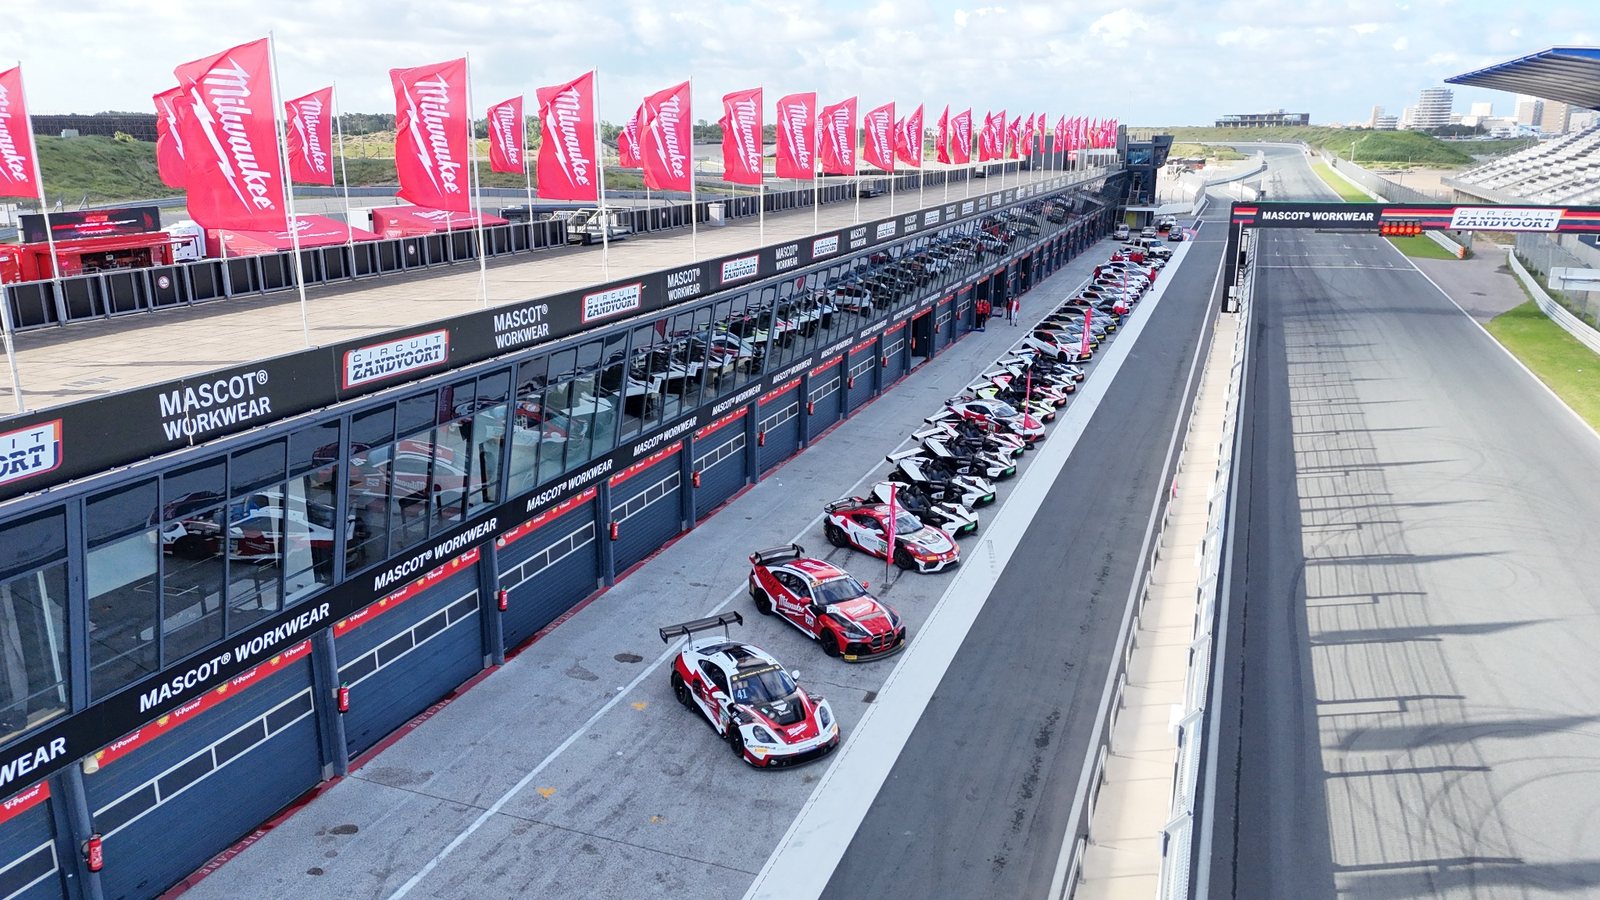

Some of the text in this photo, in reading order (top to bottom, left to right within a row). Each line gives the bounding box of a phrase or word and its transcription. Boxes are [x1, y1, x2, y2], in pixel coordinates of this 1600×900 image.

[204, 57, 272, 210] Milwaukee
[298, 97, 325, 173] Milwaukee
[414, 73, 458, 194] Milwaukee
[497, 103, 518, 165] Milwaukee
[555, 86, 588, 186] Milwaukee
[660, 94, 684, 178] Milwaukee
[736, 98, 759, 174] Milwaukee
[788, 101, 809, 169] Milwaukee
[834, 104, 851, 166] Milwaukee
[1312, 211, 1374, 222] WORKWEAR
[1456, 217, 1555, 228] ZANDVOORT
[587, 286, 637, 305] CIRCUIT
[587, 296, 637, 318] ZANDVOORT
[668, 283, 701, 301] WORKWEAR
[353, 335, 441, 362] CIRCUIT
[495, 323, 549, 349] WORKWEAR
[352, 344, 441, 381] ZANDVOORT
[162, 396, 271, 441] WORKWEAR
[663, 416, 698, 442] WORKWEAR
[568, 458, 613, 491] WORKWEAR
[434, 517, 497, 558] WORKWEAR
[235, 602, 330, 663] WORKWEAR
[284, 643, 307, 658] V-Power
[232, 670, 257, 686] V-Power
[175, 699, 201, 717] V-Power
[737, 689, 749, 700] 41
[111, 732, 140, 751] V-Power
[4, 788, 40, 810] V-Power
